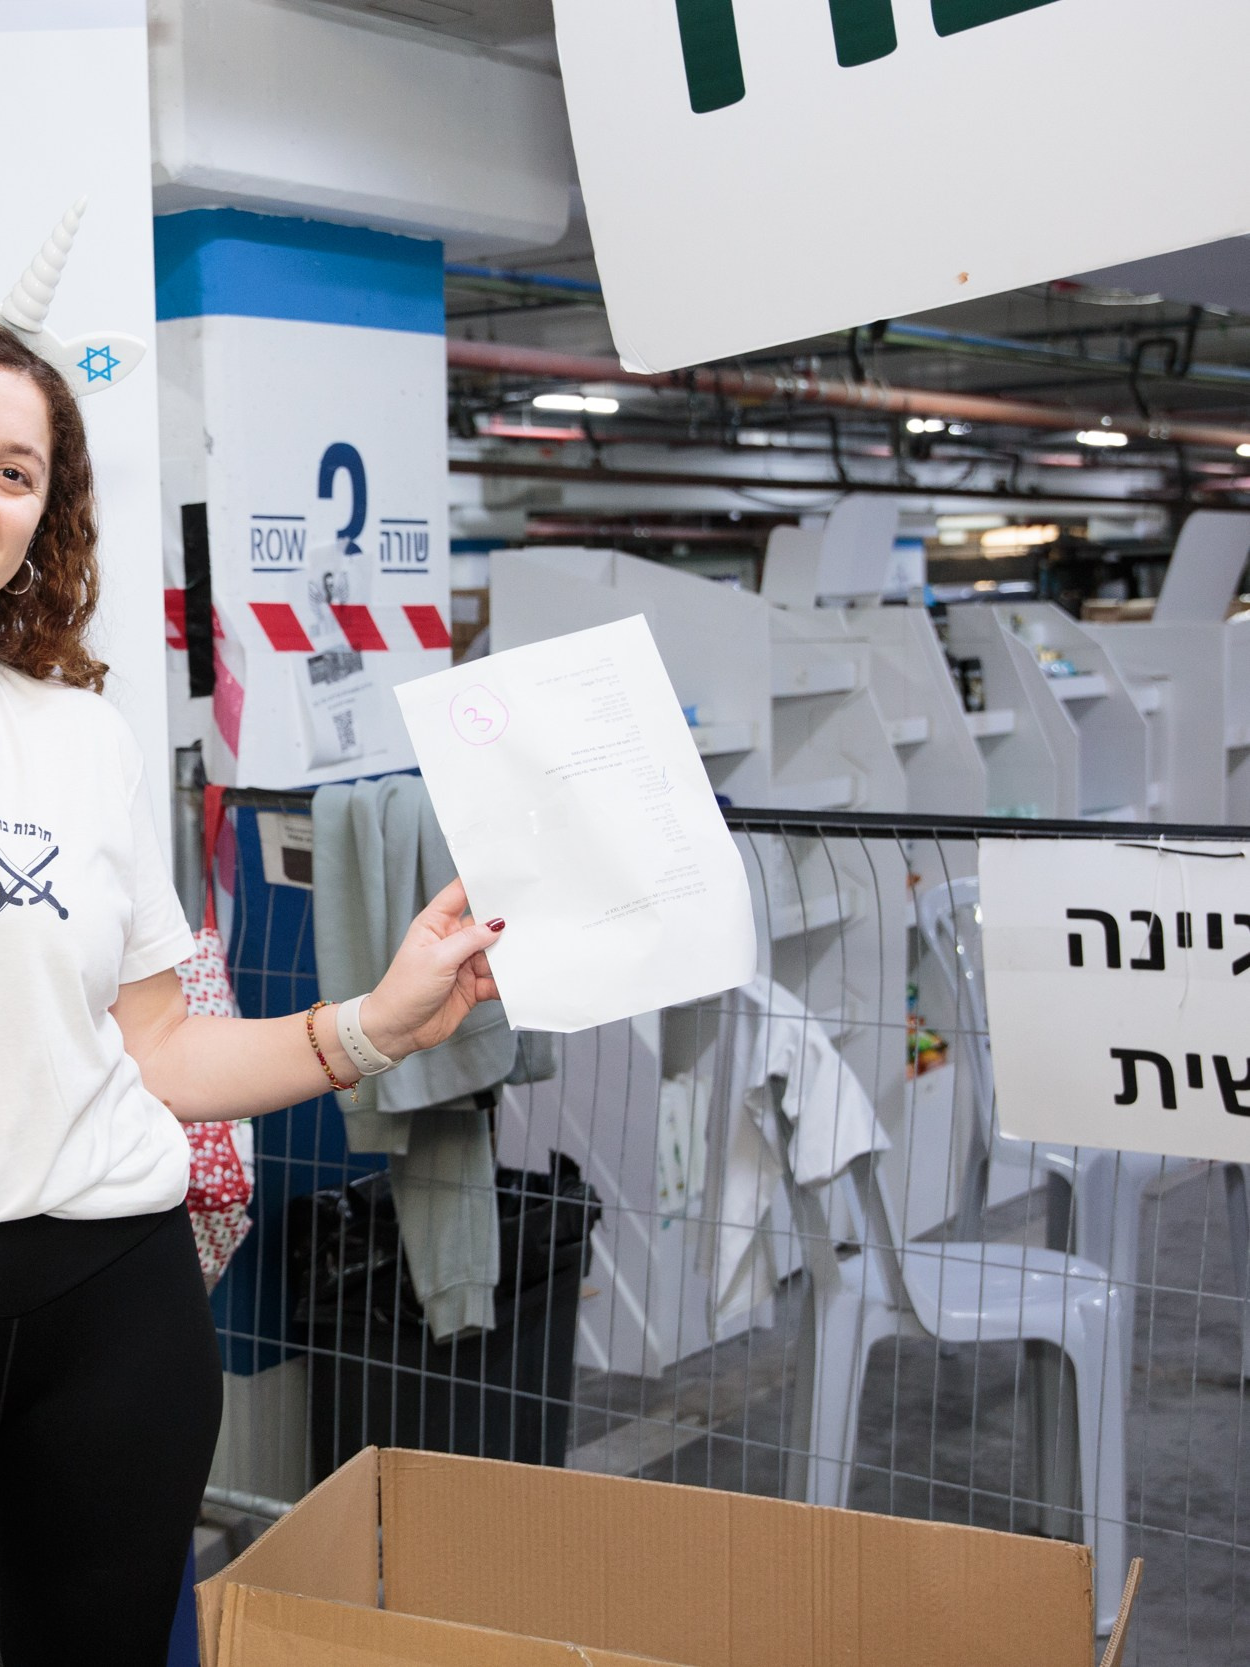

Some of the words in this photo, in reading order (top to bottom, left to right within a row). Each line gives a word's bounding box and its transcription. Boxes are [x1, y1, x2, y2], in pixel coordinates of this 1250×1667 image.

[251, 528, 306, 562] ROW
[379, 531, 429, 563] שורה
[463, 707, 493, 733] 3
[1110, 1047, 1250, 1117] שית
